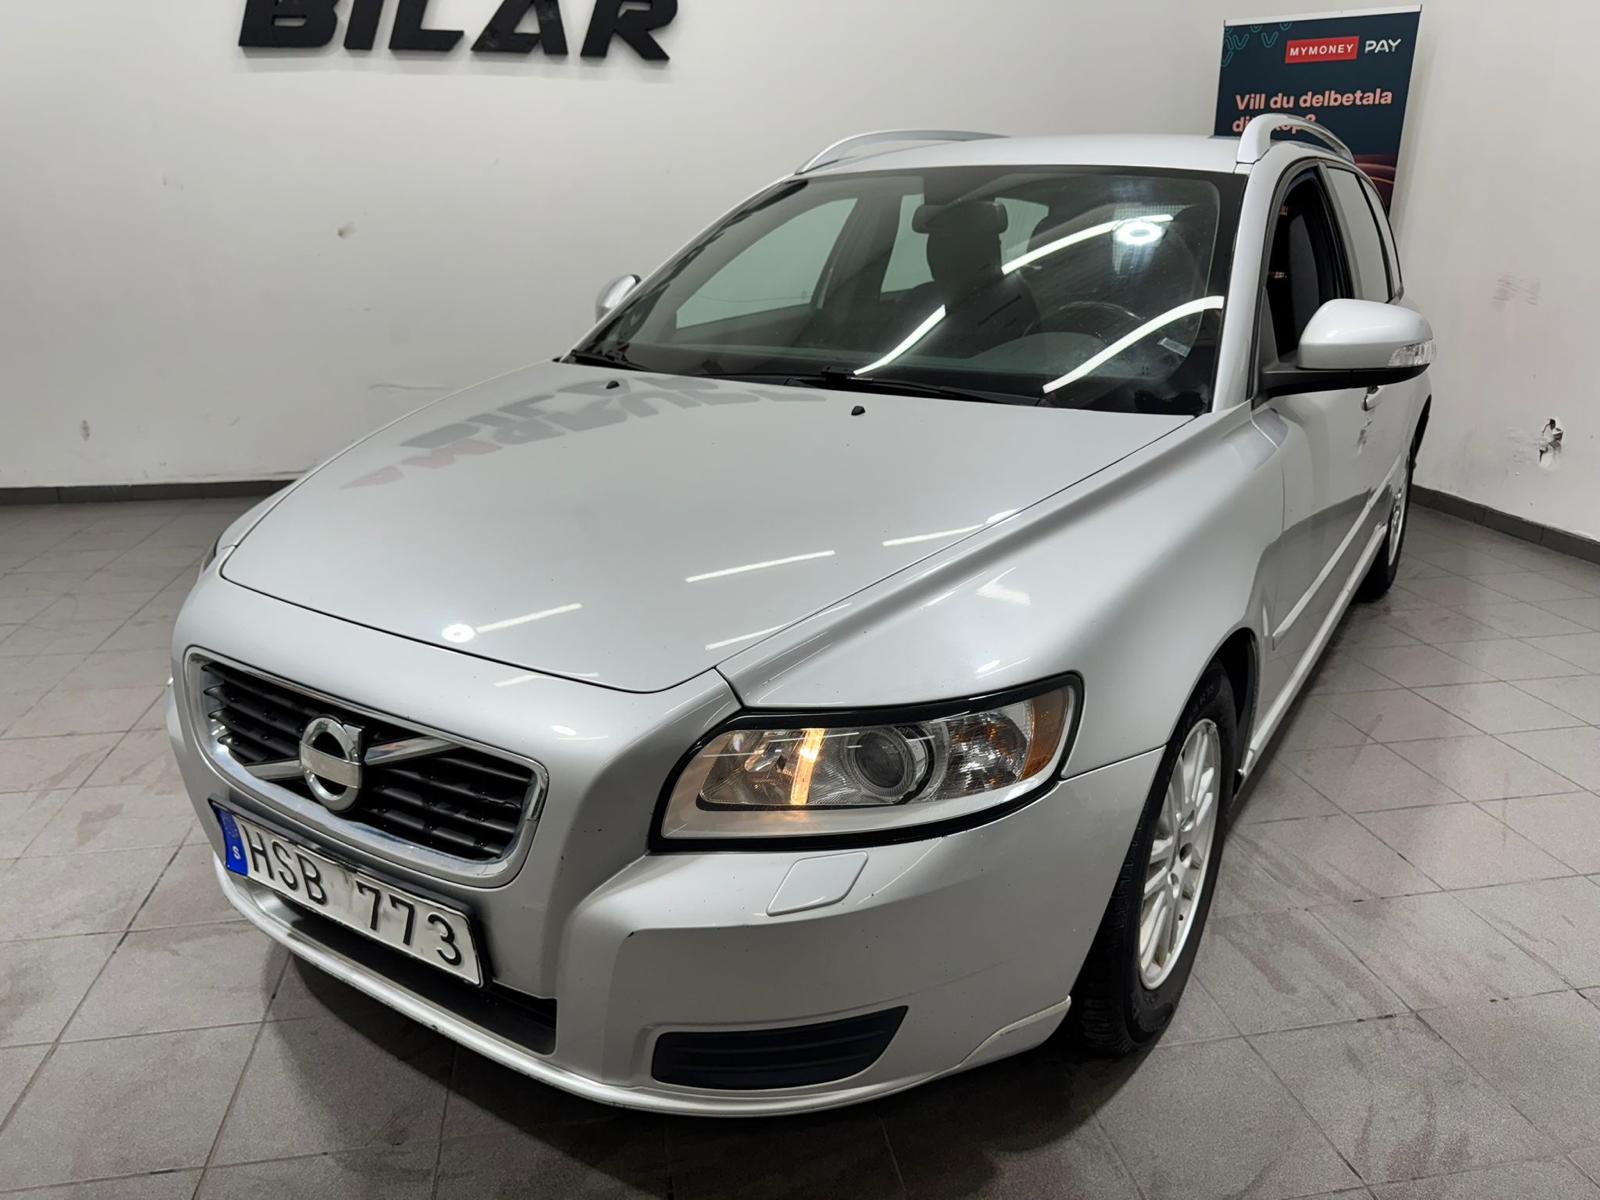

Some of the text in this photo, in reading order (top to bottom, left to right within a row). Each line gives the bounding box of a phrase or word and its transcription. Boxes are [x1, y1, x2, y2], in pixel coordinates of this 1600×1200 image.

[237, 0, 678, 61] BILAR
[1289, 38, 1402, 57] MYMONEY PAY
[1235, 88, 1393, 111] Vill du delbetala
[241, 823, 462, 967] HSB 773
